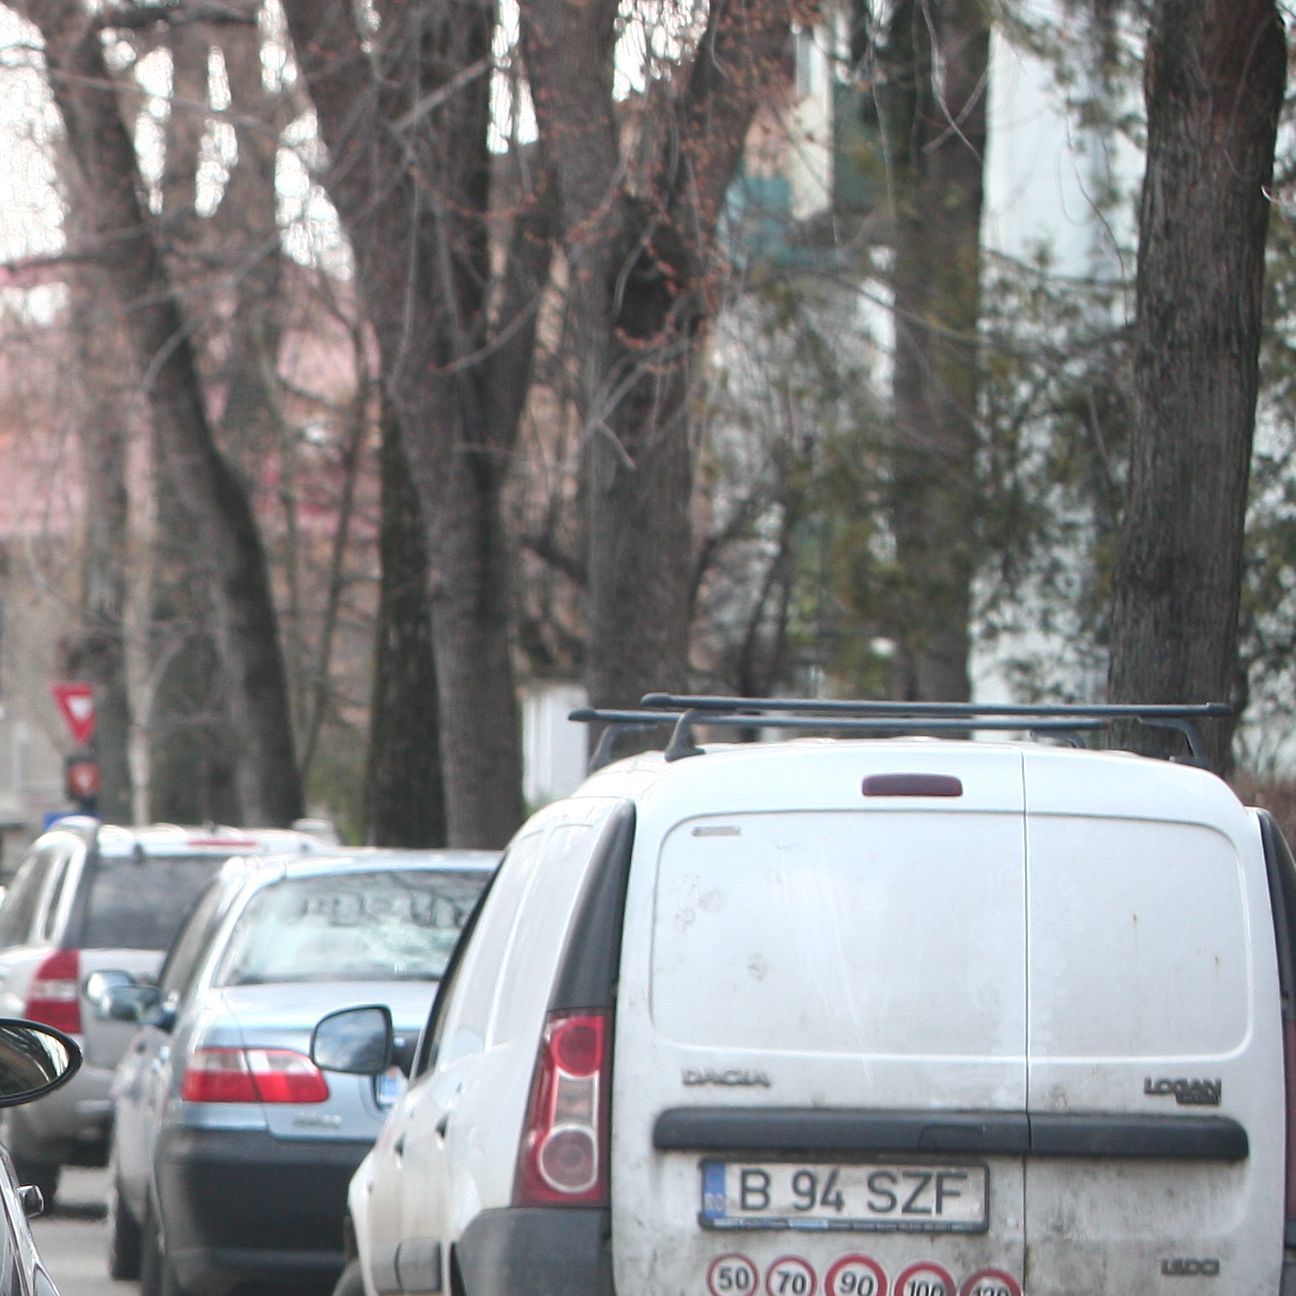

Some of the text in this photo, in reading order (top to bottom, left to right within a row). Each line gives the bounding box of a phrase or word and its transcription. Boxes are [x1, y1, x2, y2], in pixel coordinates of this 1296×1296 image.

[740, 1168, 968, 1215] B 94 SZF
[718, 1266, 749, 1291] 50
[776, 1270, 807, 1296] 70
